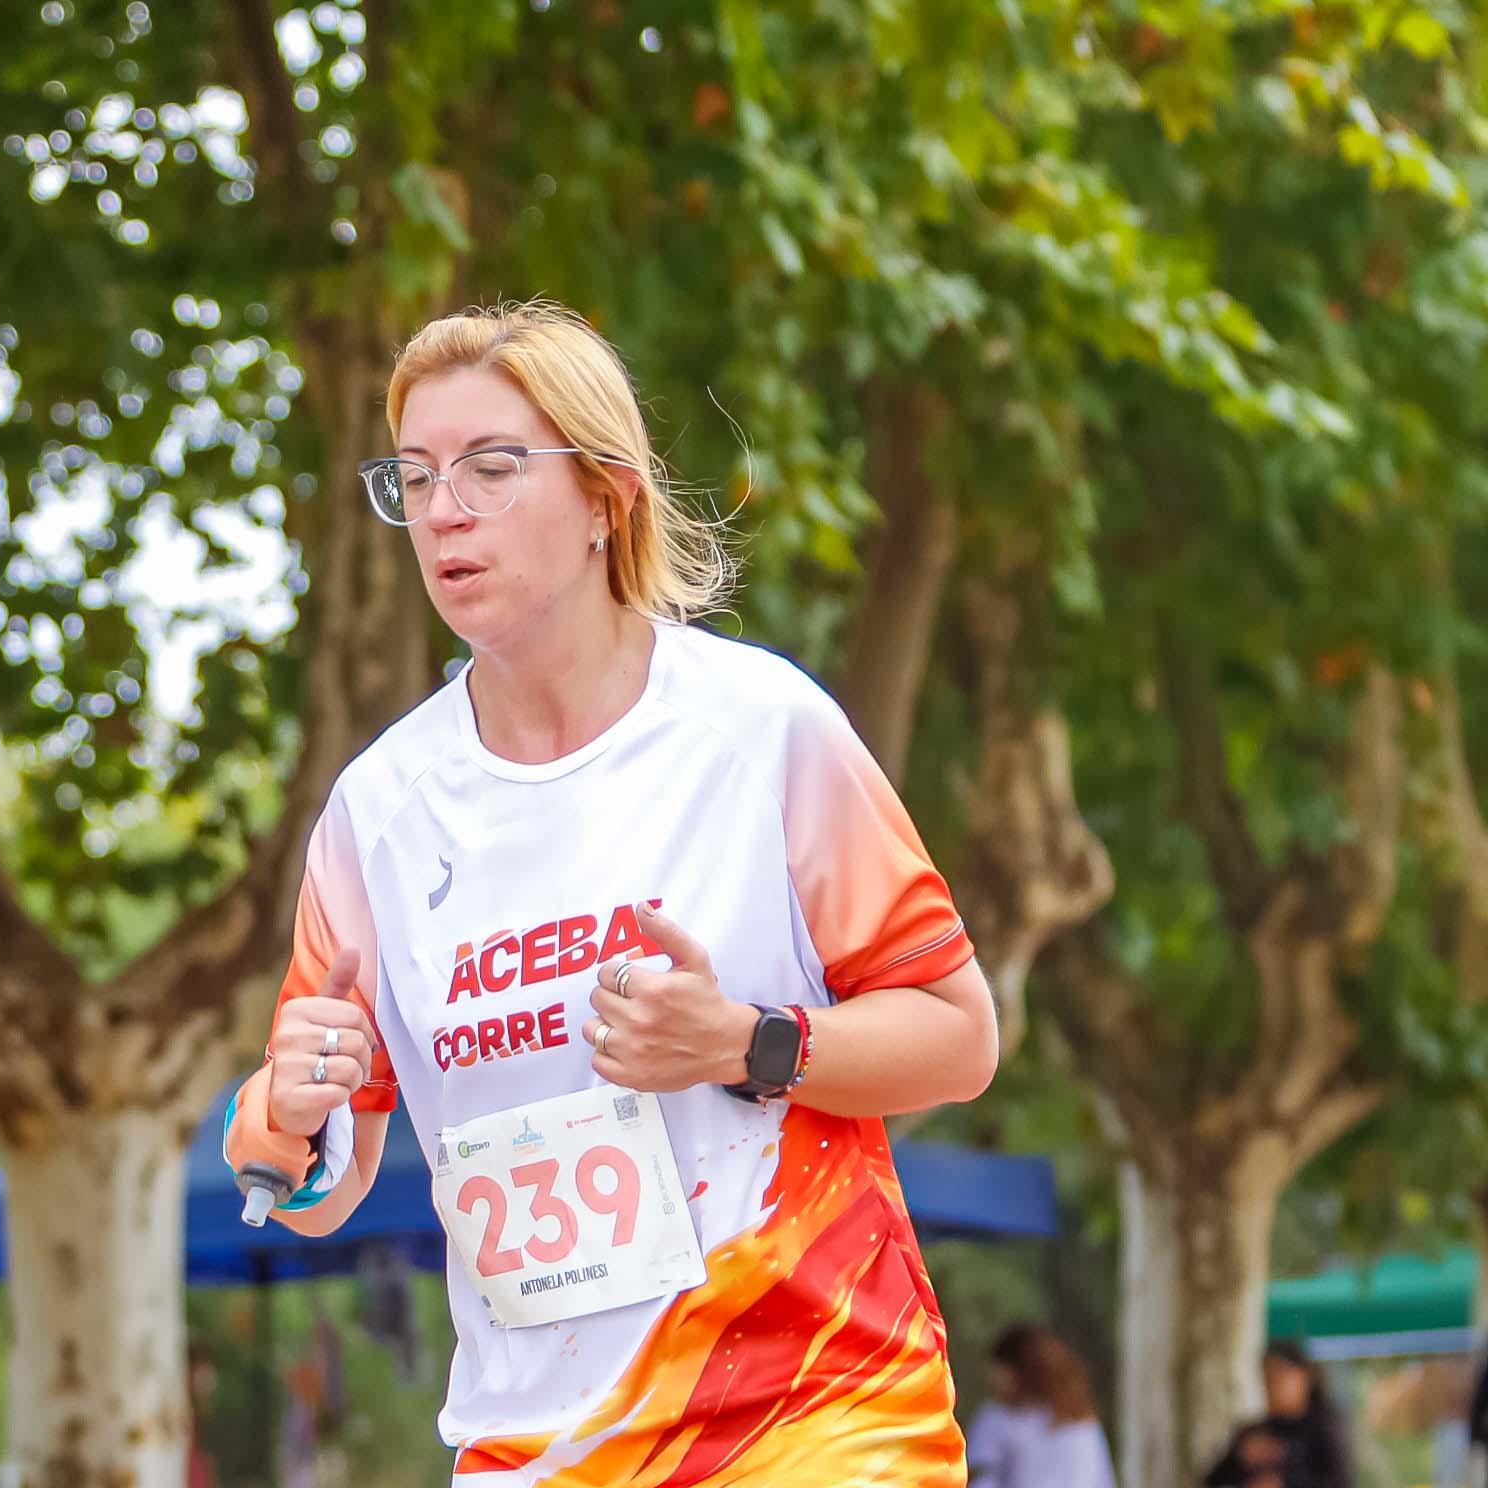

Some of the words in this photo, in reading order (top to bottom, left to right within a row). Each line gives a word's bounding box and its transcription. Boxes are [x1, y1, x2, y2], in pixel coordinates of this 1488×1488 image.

[432, 1002, 569, 1073] CORRE
[456, 1144, 641, 1278] 239
[520, 1272, 563, 1297] ANTONELA
[564, 1263, 608, 1288] POLINESI
